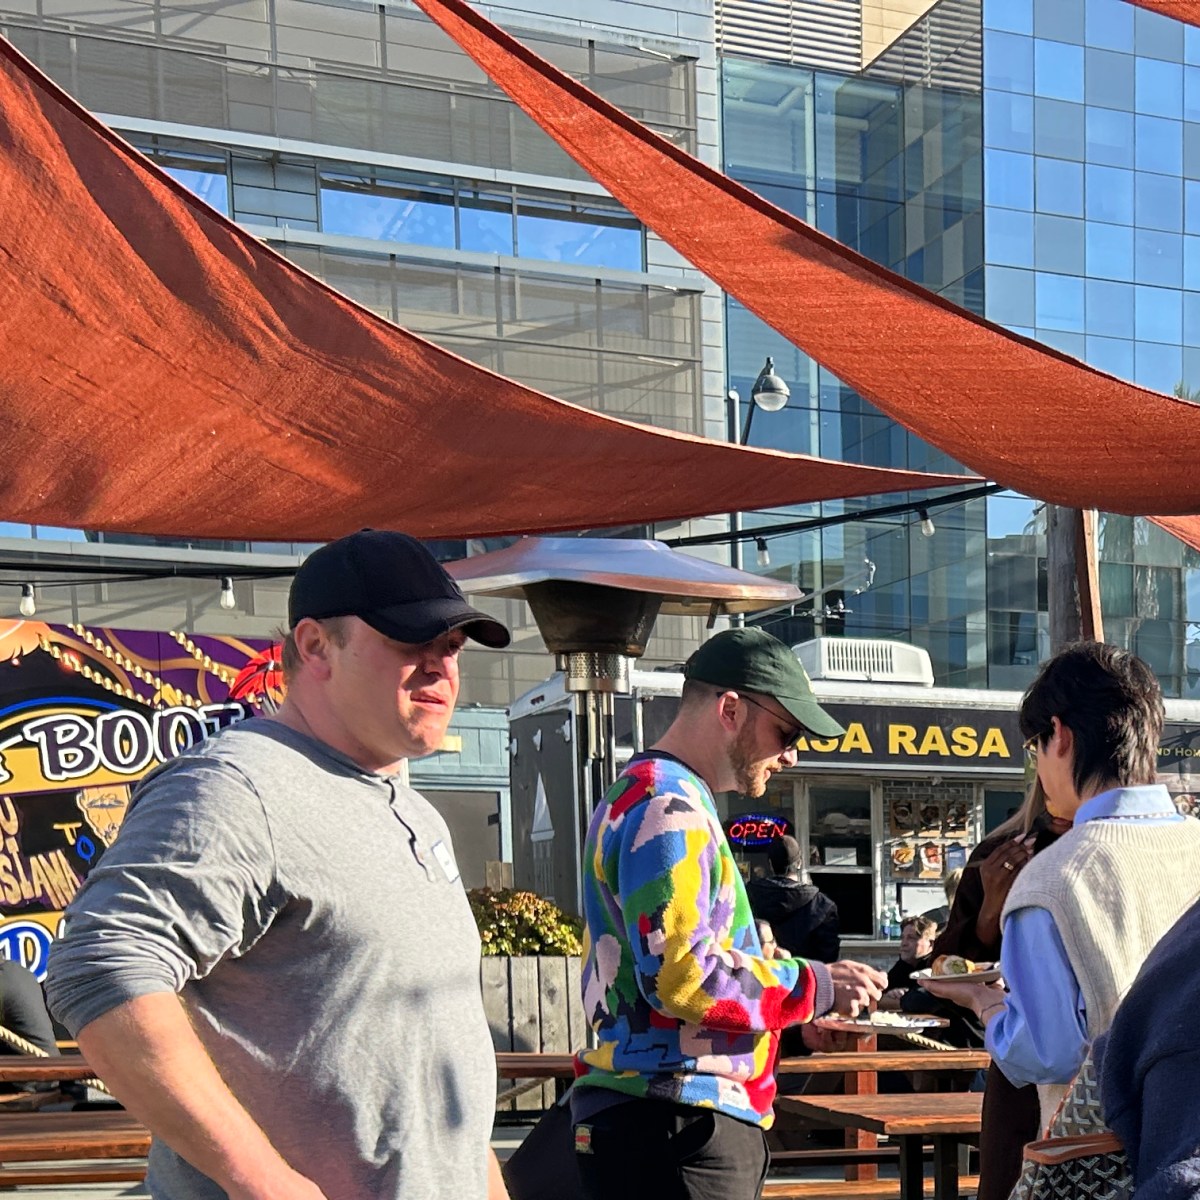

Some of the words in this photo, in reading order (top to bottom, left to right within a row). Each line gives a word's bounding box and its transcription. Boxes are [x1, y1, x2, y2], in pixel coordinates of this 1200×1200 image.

[888, 724, 1011, 758] RASA
[1156, 747, 1171, 757] ND
[729, 822, 788, 839] OPEN
